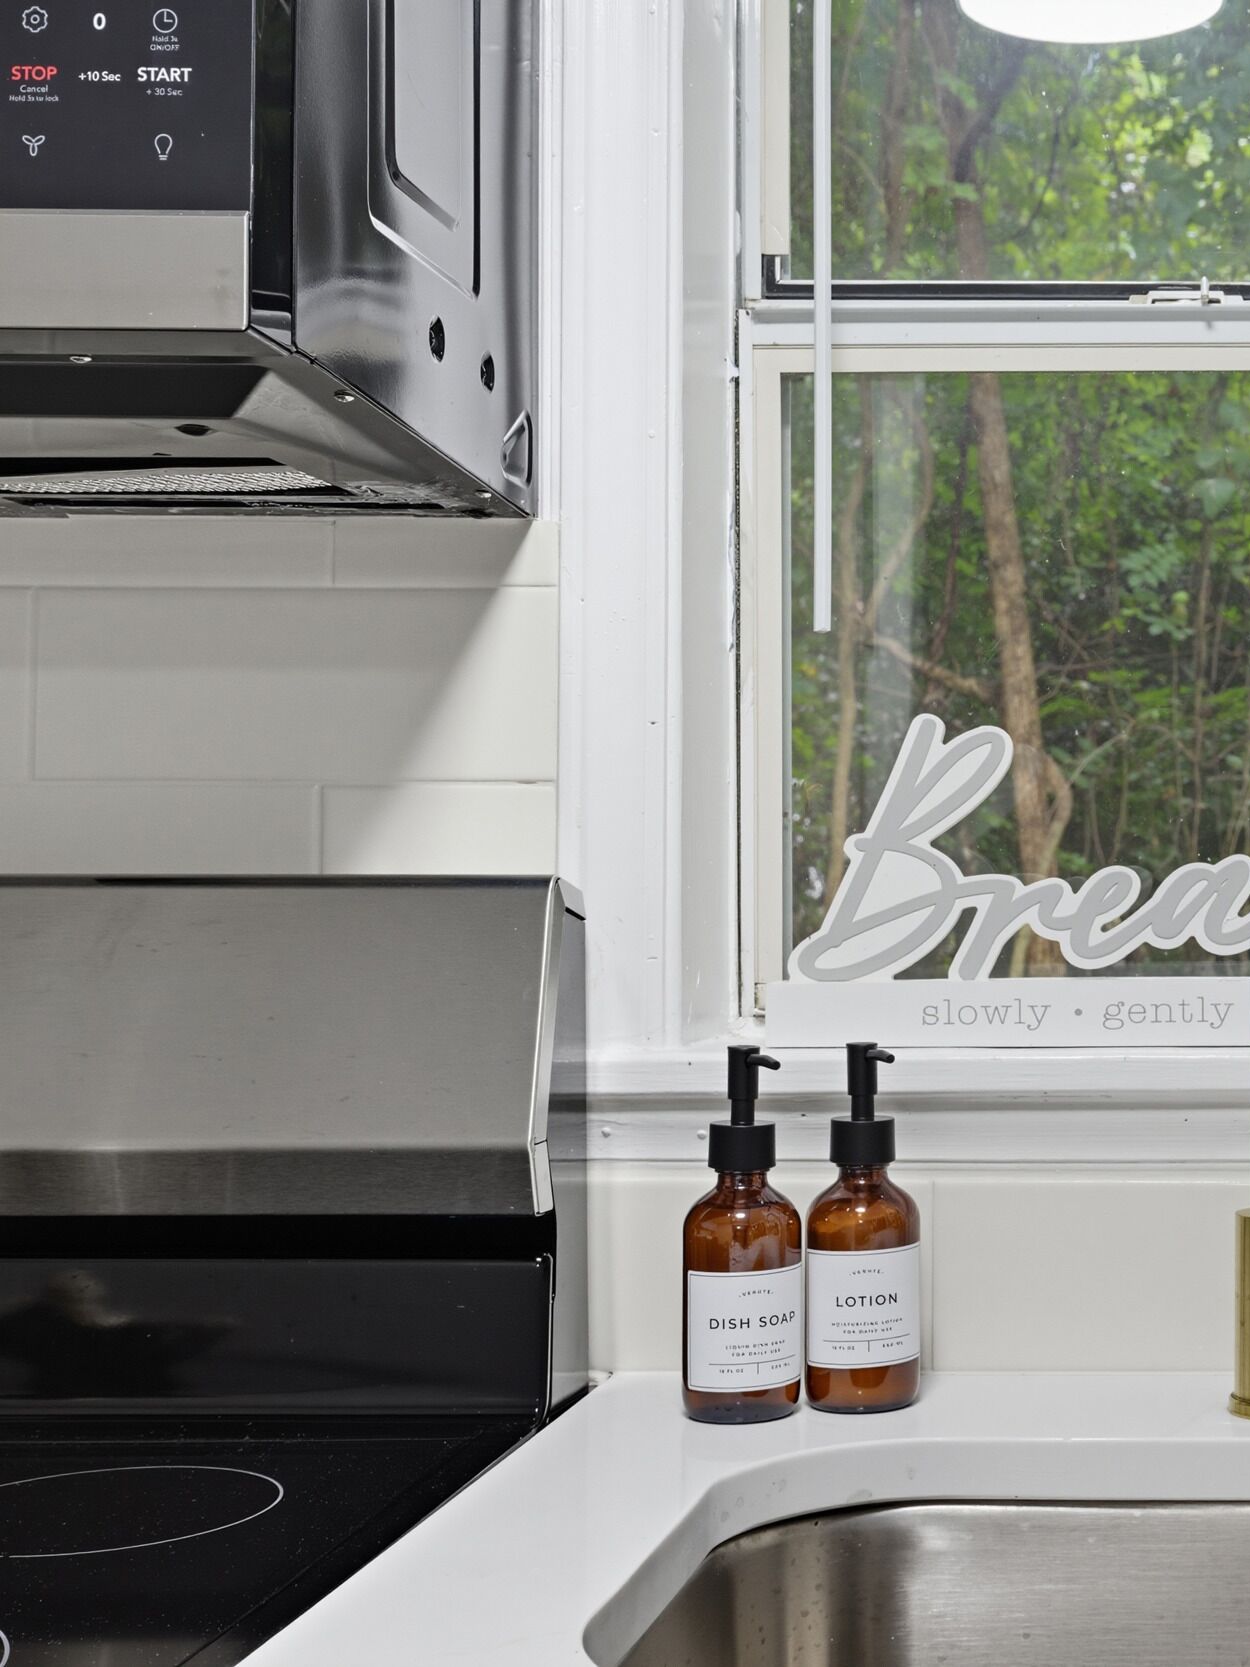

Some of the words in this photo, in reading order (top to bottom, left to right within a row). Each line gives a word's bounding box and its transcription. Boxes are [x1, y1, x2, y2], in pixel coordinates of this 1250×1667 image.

[92, 13, 107, 31] 0
[11, 65, 58, 81] STOP
[78, 71, 100, 82] +10
[101, 71, 121, 82] Sec
[137, 66, 193, 82] START
[19, 84, 49, 93] Cancel
[154, 87, 166, 96] 30
[167, 87, 183, 96] Sec
[9, 94, 26, 102] Hold
[45, 94, 60, 102] lock
[921, 998, 1052, 1032] slowly
[1102, 997, 1235, 1031] gently
[836, 1292, 898, 1307] LOTION
[709, 1318, 750, 1330] DISH
[759, 1310, 796, 1328] SOAP
